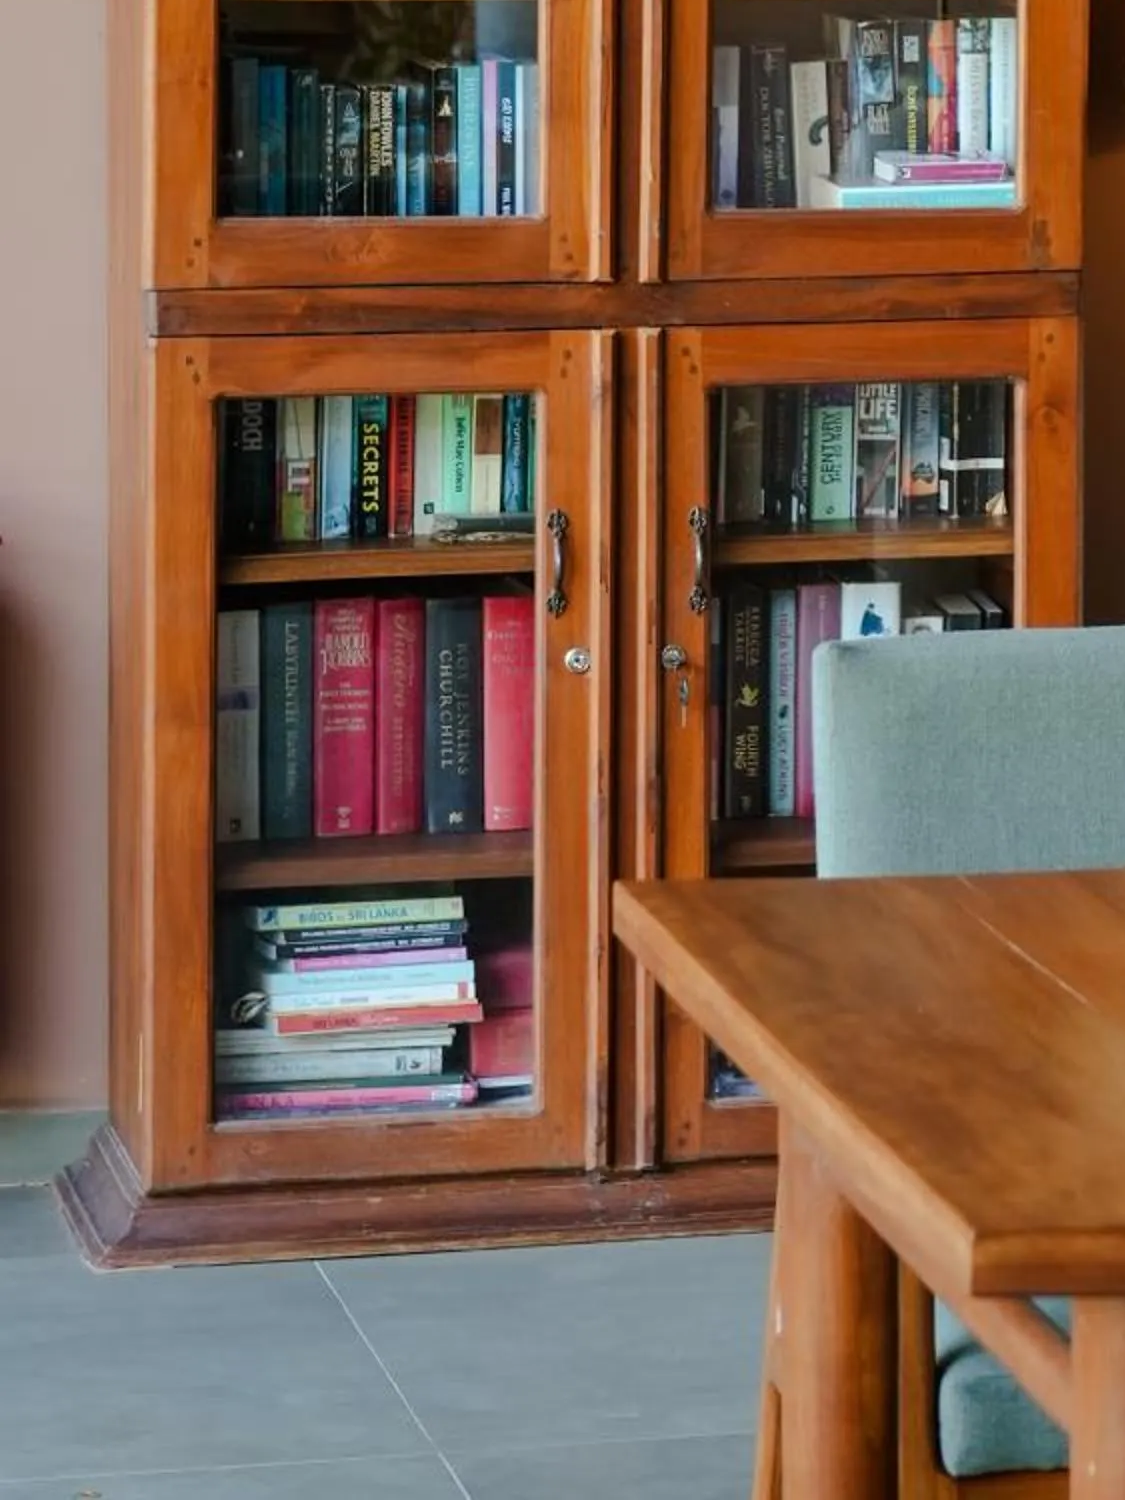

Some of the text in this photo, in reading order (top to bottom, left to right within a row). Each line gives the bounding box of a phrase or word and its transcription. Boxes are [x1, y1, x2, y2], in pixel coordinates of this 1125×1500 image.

[369, 90, 381, 177] DANIEL MARTIN
[381, 90, 393, 167] JOHN FOWLES
[859, 400, 897, 420] LIFE
[860, 384, 897, 398] LITTLE
[362, 422, 380, 513] SECRETS
[820, 410, 836, 485] CENTURY
[285, 620, 300, 724] LABYRINTH
[438, 649, 453, 770] CHURCHILL
[454, 691, 471, 776] JENKINS
[734, 734, 746, 771] WING
[746, 725, 760, 778] FOURTH
[368, 906, 409, 919] LANKA
